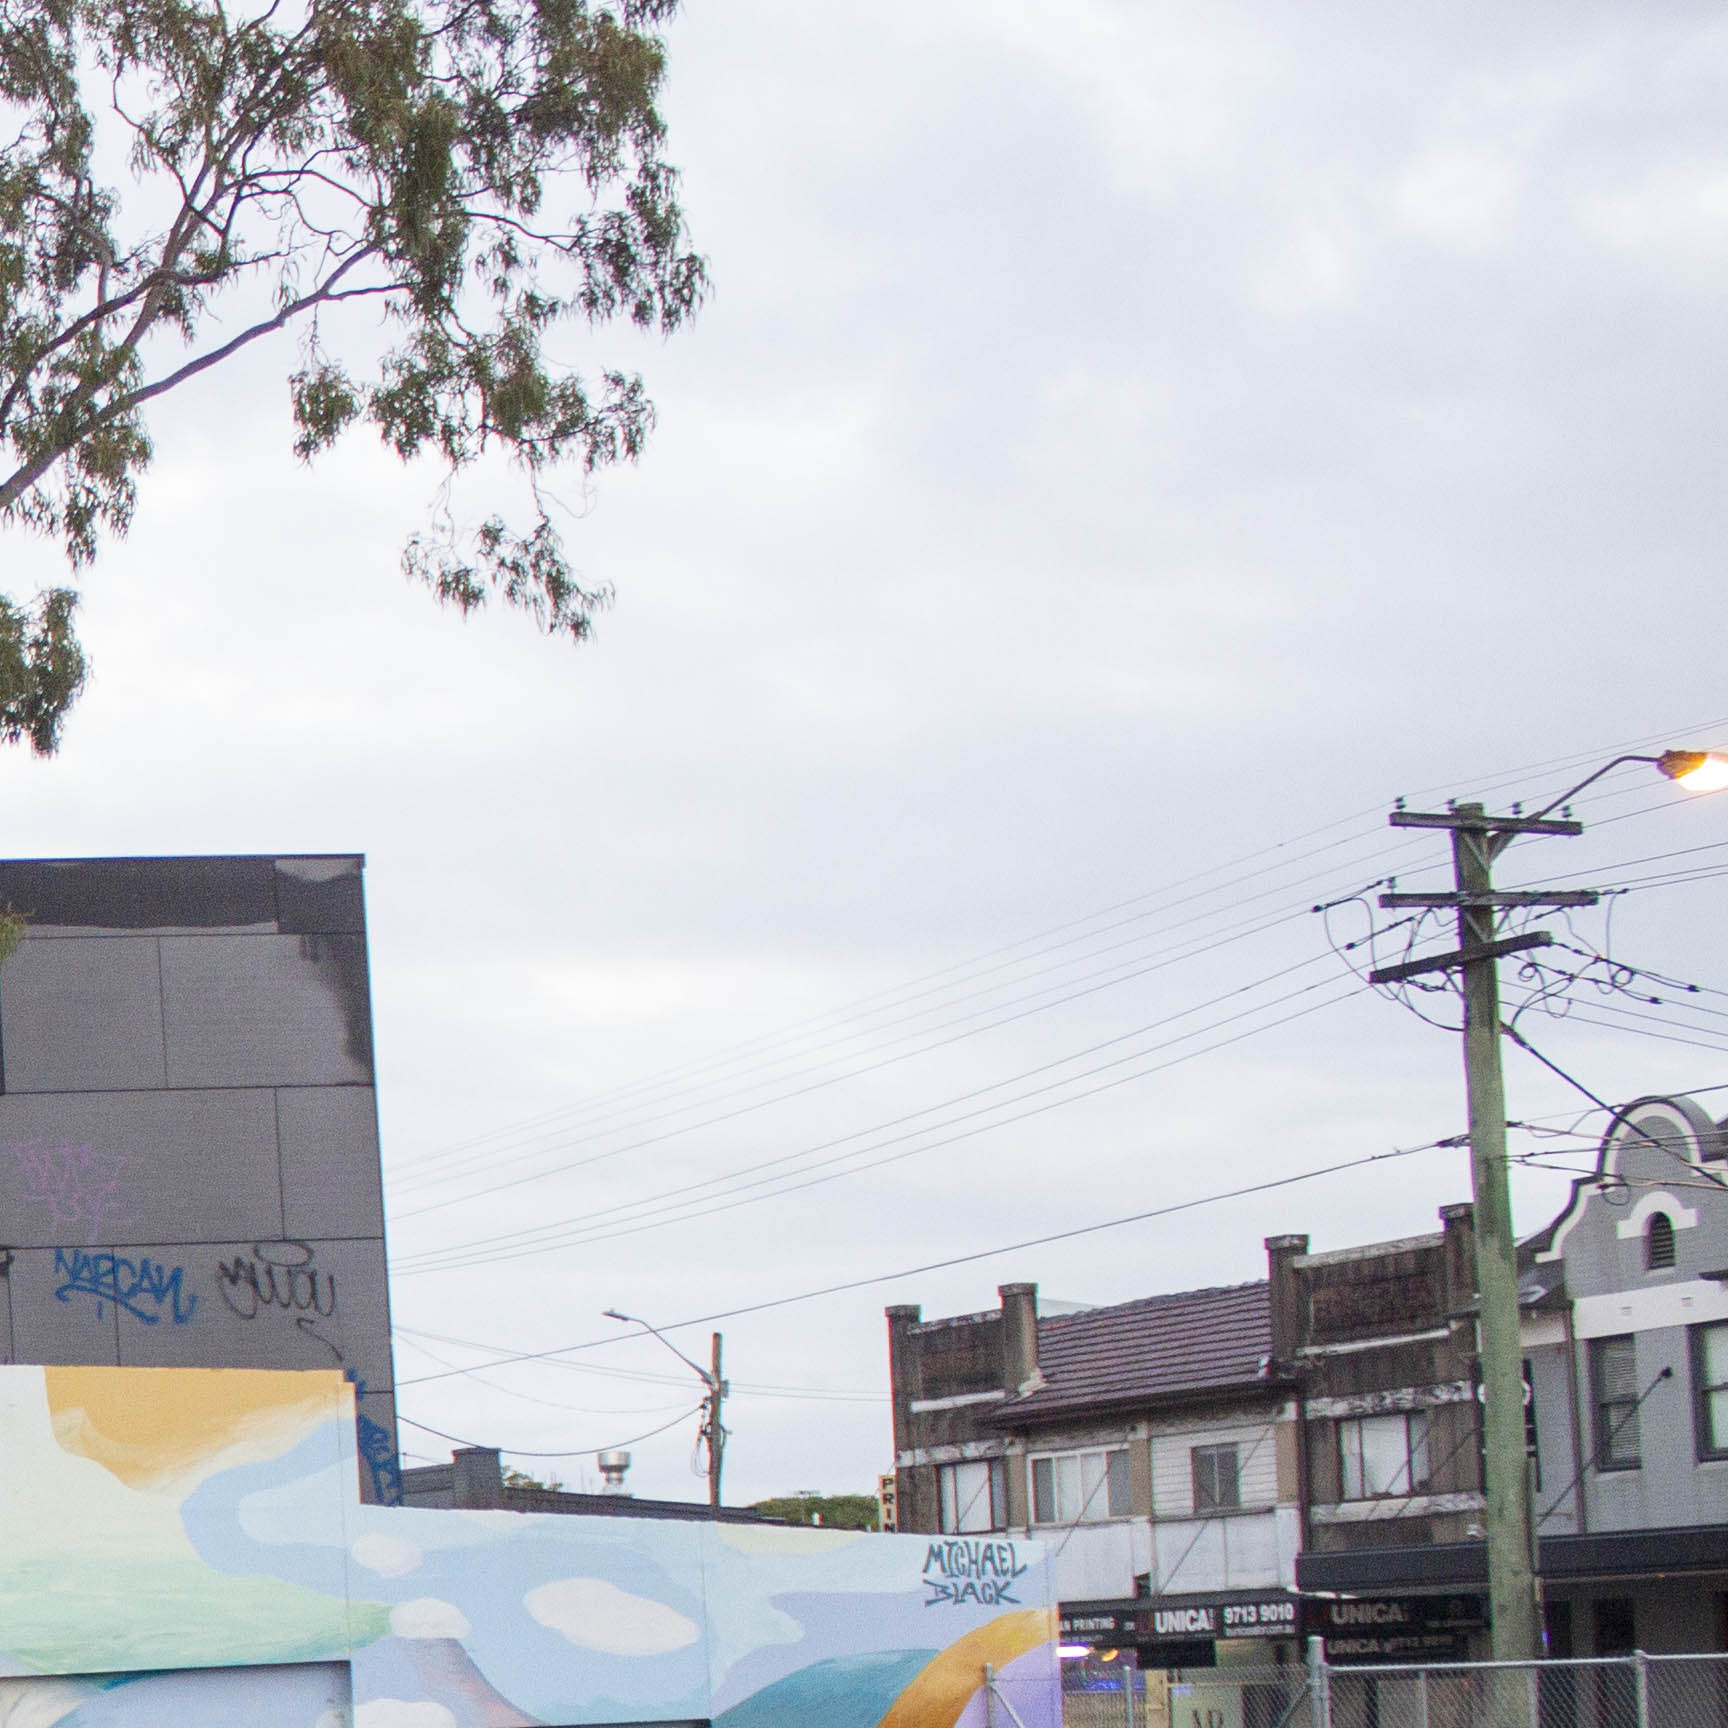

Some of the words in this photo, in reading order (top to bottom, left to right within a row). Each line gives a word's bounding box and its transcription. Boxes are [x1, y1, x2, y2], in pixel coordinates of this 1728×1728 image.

[922, 1541, 1028, 1579] MICHAEL
[923, 1579, 1022, 1607] BLACK
[1072, 1616, 1115, 1631] PRINTING
[1154, 1608, 1209, 1633] UNICA
[1224, 1606, 1258, 1624] 9713
[1260, 1602, 1295, 1621] 9010
[1331, 1603, 1404, 1624] UNICA
